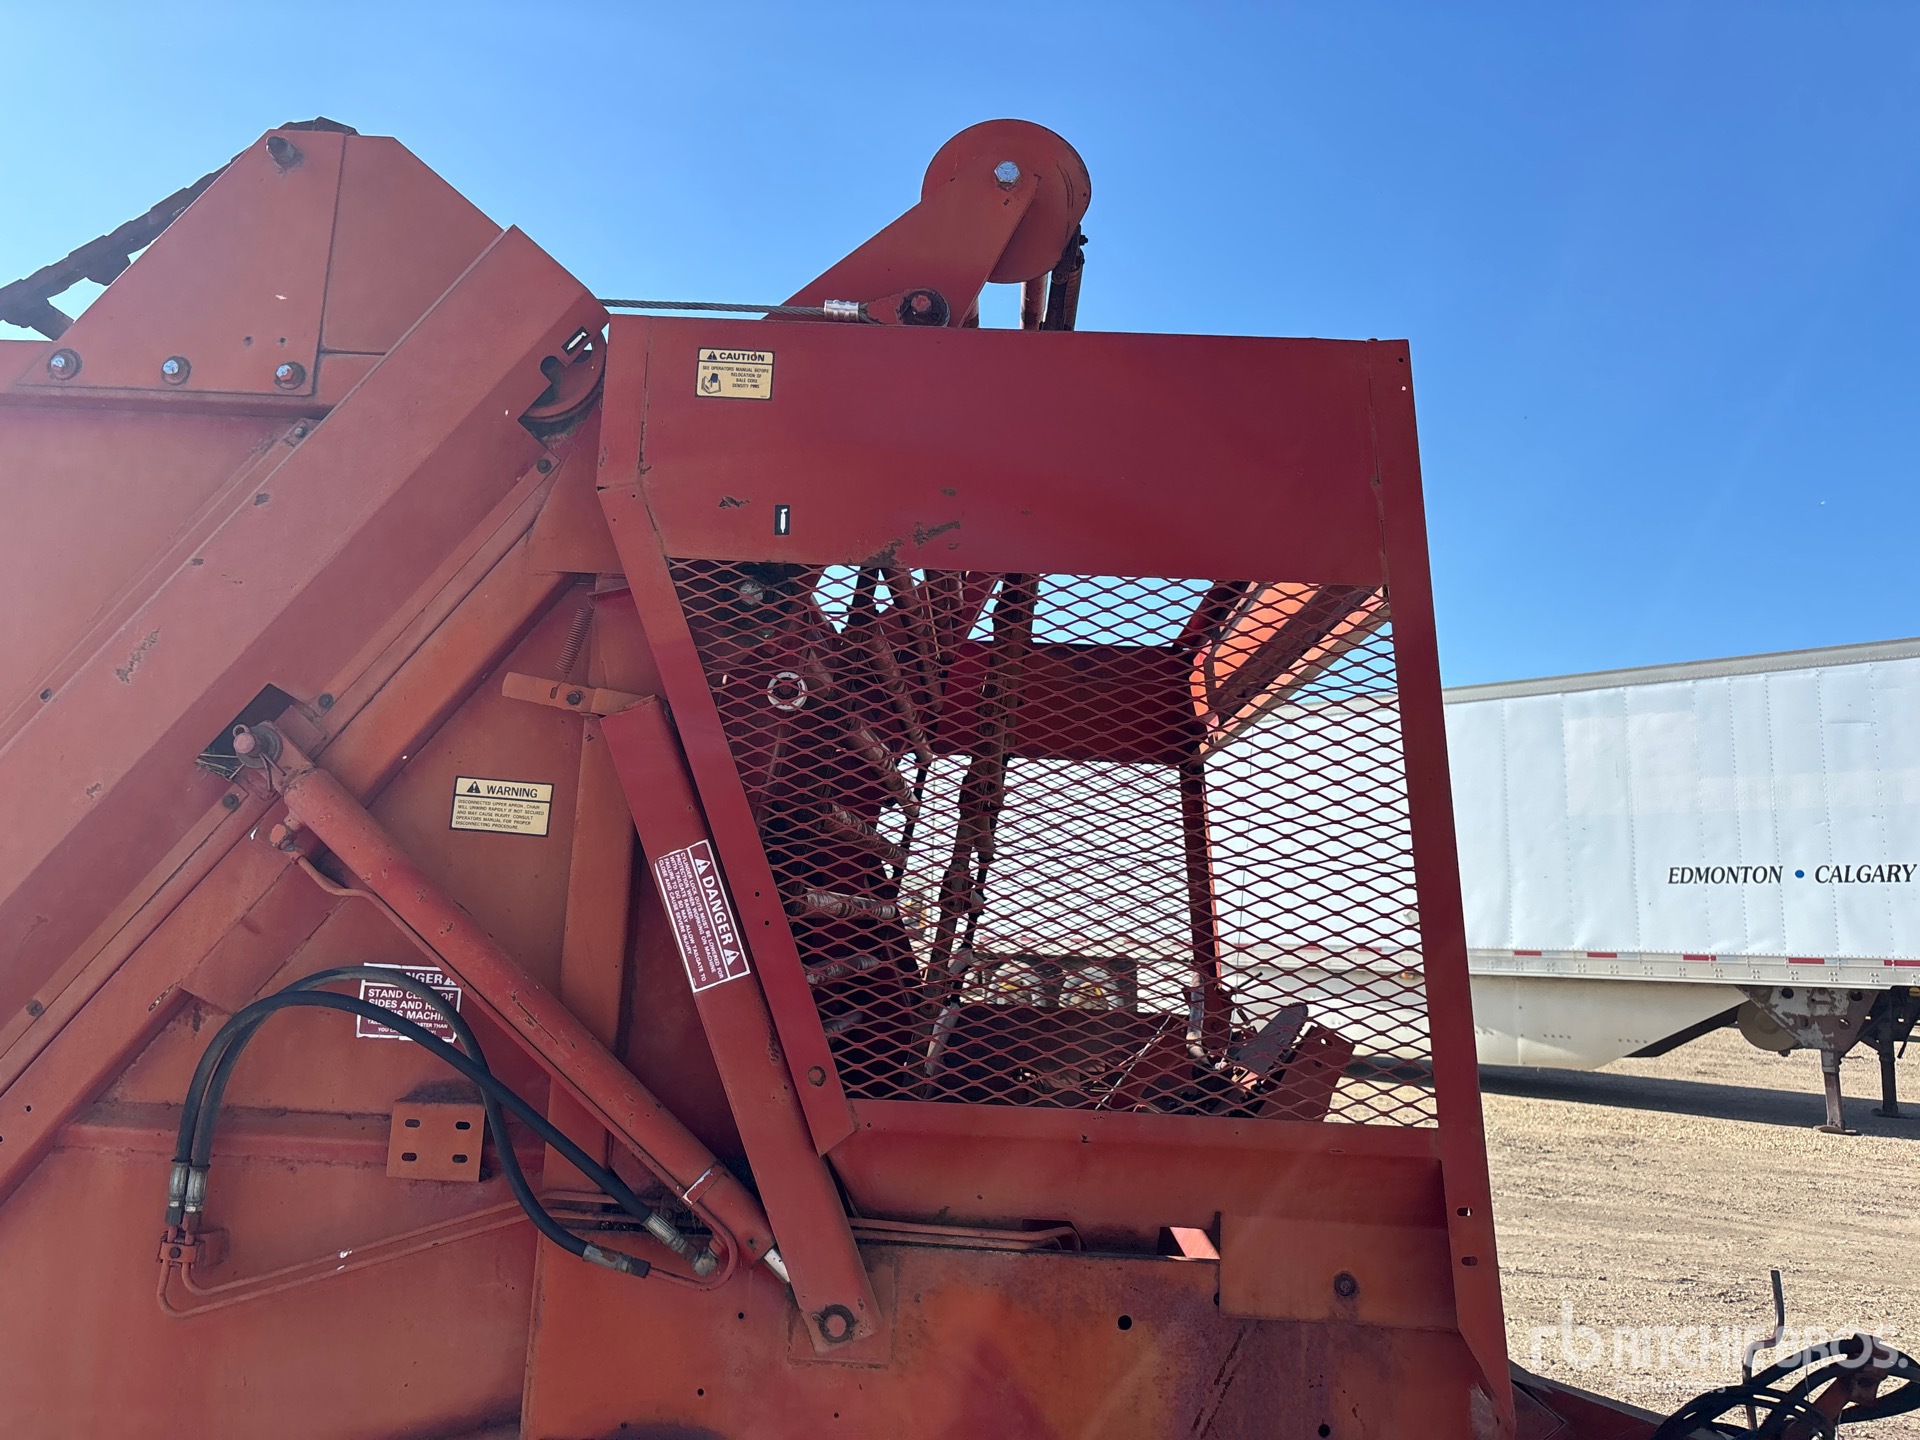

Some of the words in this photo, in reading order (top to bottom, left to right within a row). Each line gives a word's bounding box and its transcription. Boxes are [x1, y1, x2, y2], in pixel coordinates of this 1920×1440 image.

[720, 353, 765, 361] CAUTION
[487, 785, 538, 798] WARNING
[664, 858, 675, 880] FAILURE
[1668, 866, 1783, 884] EDMONTON
[1815, 864, 1917, 883] CALGARY
[670, 856, 678, 870] WITH
[675, 871, 686, 898] TAILGATE
[683, 899, 694, 921] RAISED.
[673, 881, 678, 889] TO
[675, 890, 681, 899] DO
[659, 860, 668, 877] CLOSE
[670, 892, 678, 911] CAUSE
[676, 912, 685, 933] SEVERE
[682, 934, 692, 956] INJURY.
[676, 854, 690, 888] PROTECTION
[686, 889, 695, 906] WHEN
[692, 907, 704, 935] WORKING
[701, 936, 707, 945] ON
[704, 946, 716, 973] MACHINE
[678, 901, 684, 909] SO
[702, 875, 734, 945] DANGER
[681, 852, 692, 879] CYLINDER
[689, 880, 697, 895] LOCK
[694, 896, 703, 911] OUTS
[699, 912, 708, 929] MUST
[708, 939, 720, 966] LOWERED
[716, 967, 724, 979] FOR
[685, 924, 695, 944] ALLOW
[692, 946, 703, 973] TAILGATE
[700, 974, 706, 982] TO
[368, 989, 403, 998] STAND
[400, 1001, 422, 1009] AND
